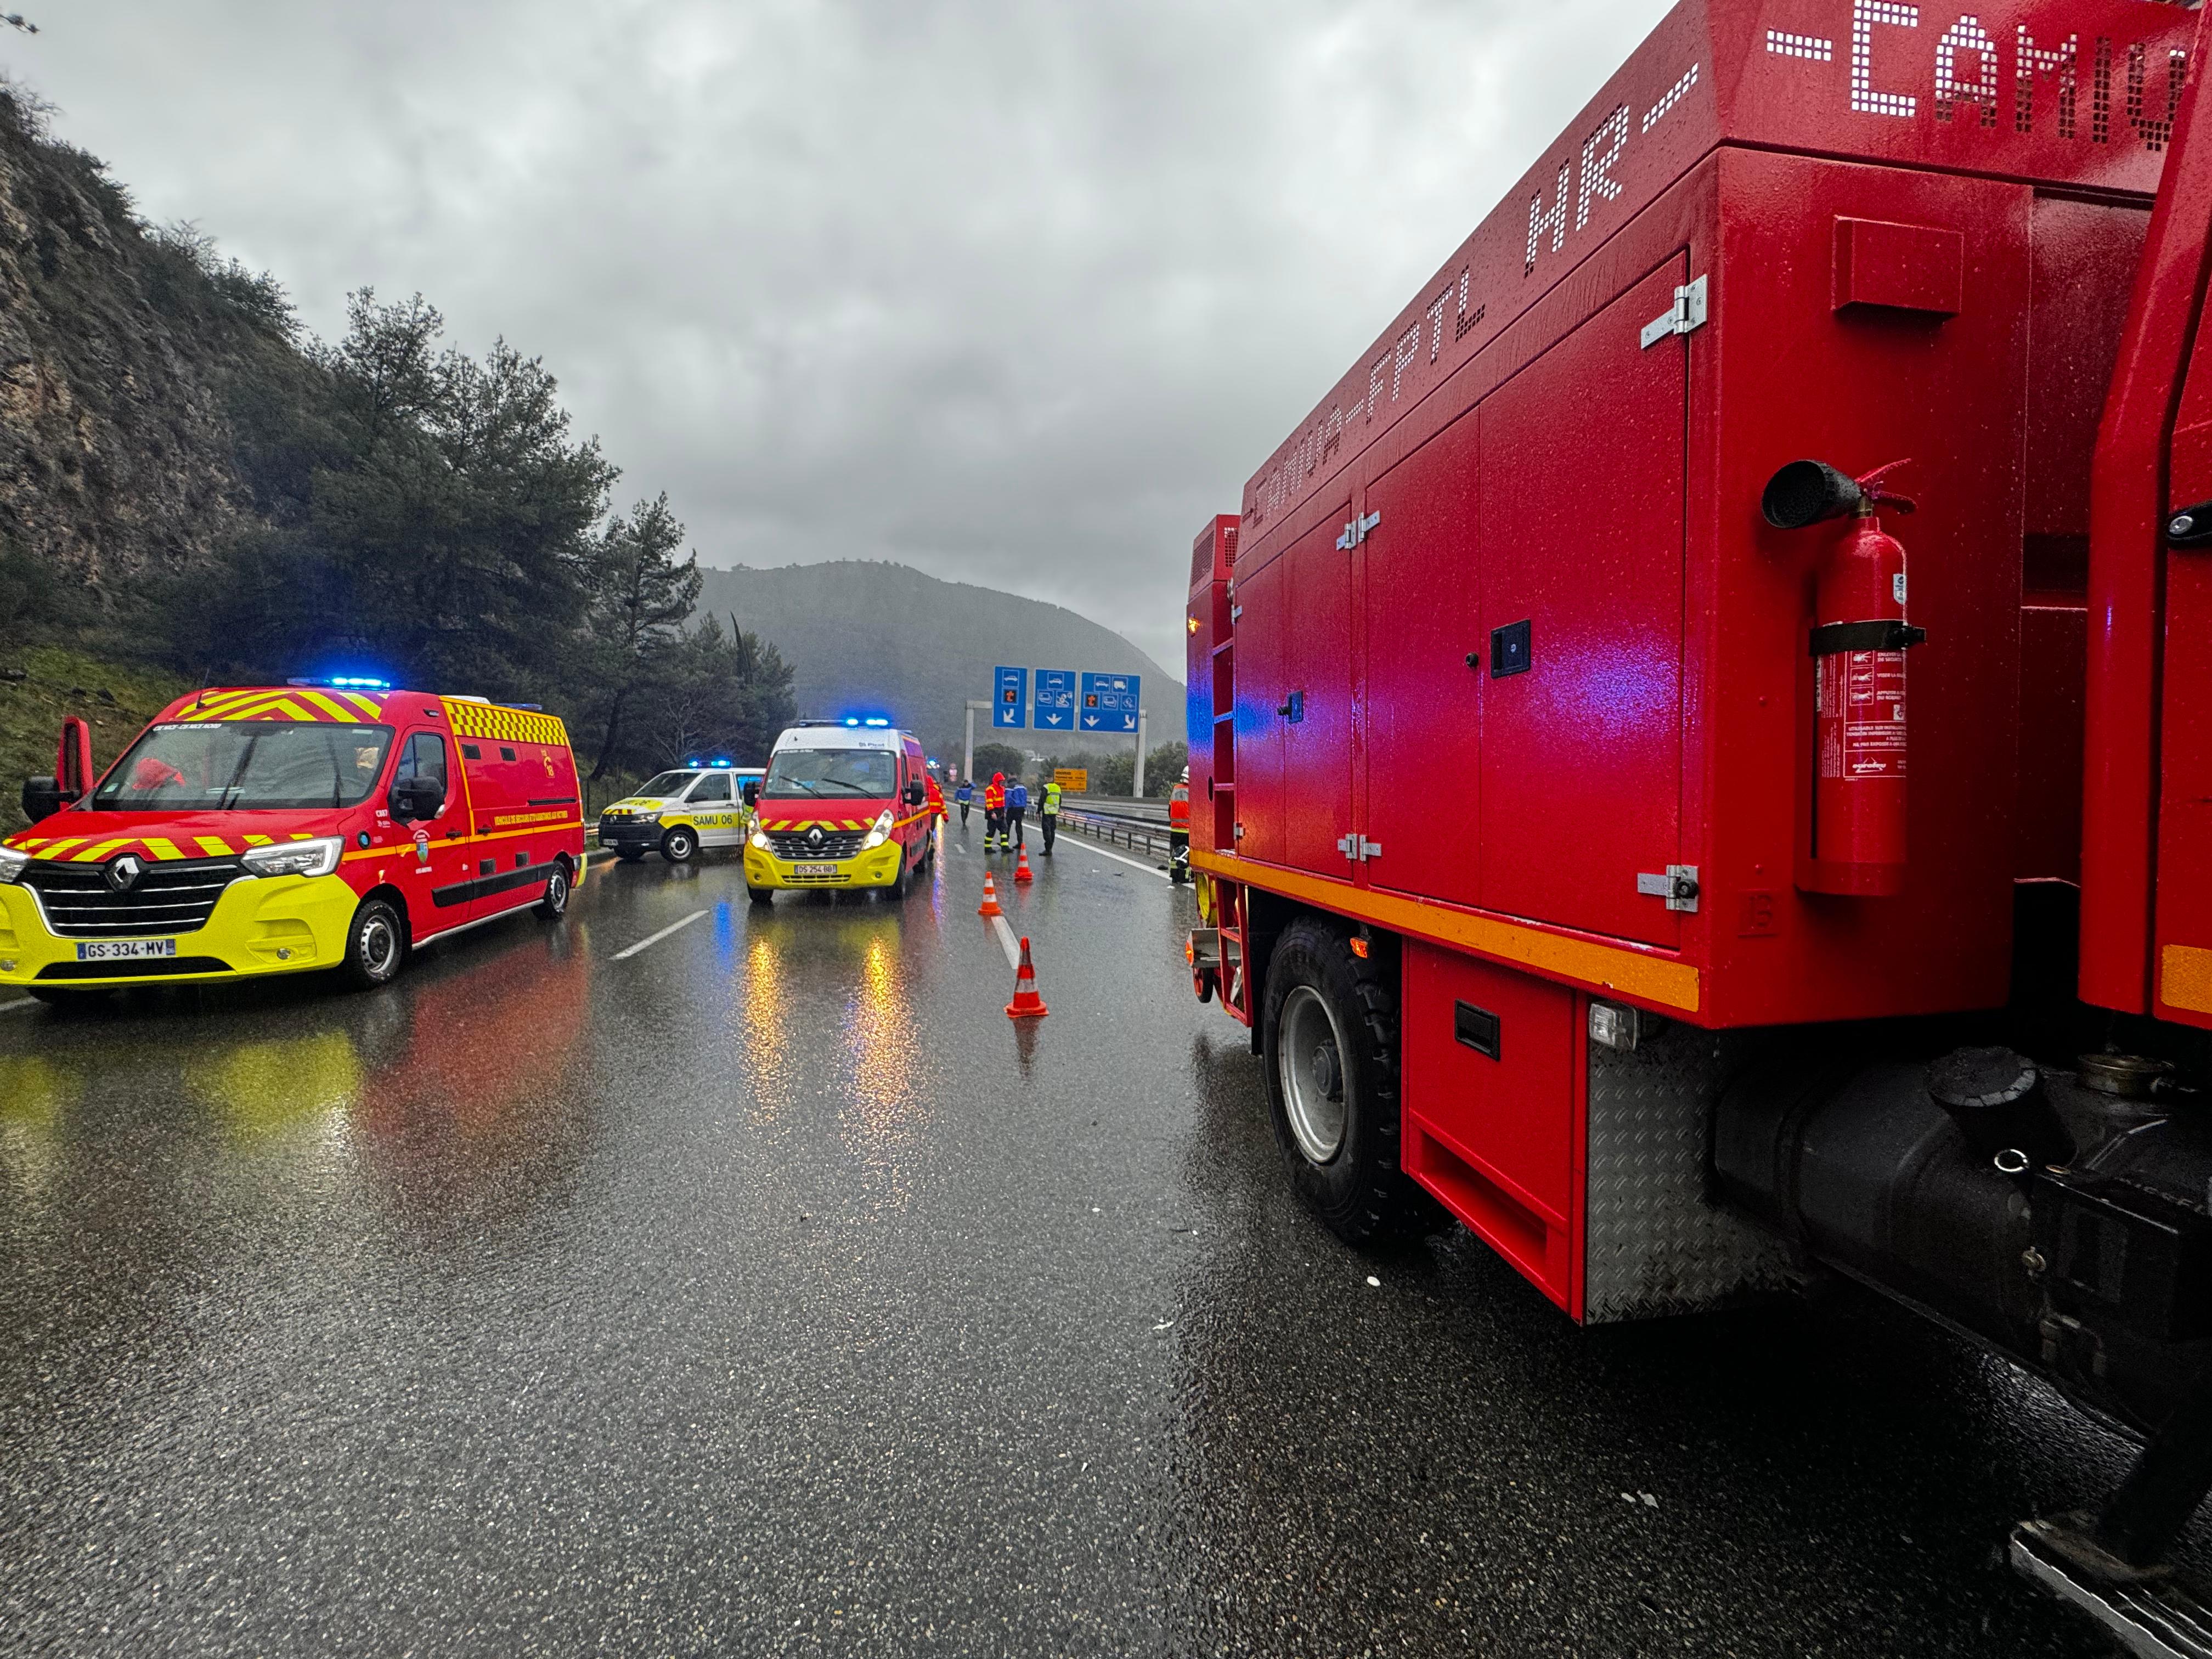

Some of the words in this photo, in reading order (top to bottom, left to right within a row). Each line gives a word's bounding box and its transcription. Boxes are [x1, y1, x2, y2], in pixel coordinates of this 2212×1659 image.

[693, 815, 718, 826] SAMU
[721, 815, 733, 825] 06
[88, 941, 164, 958] GS-334-MV
